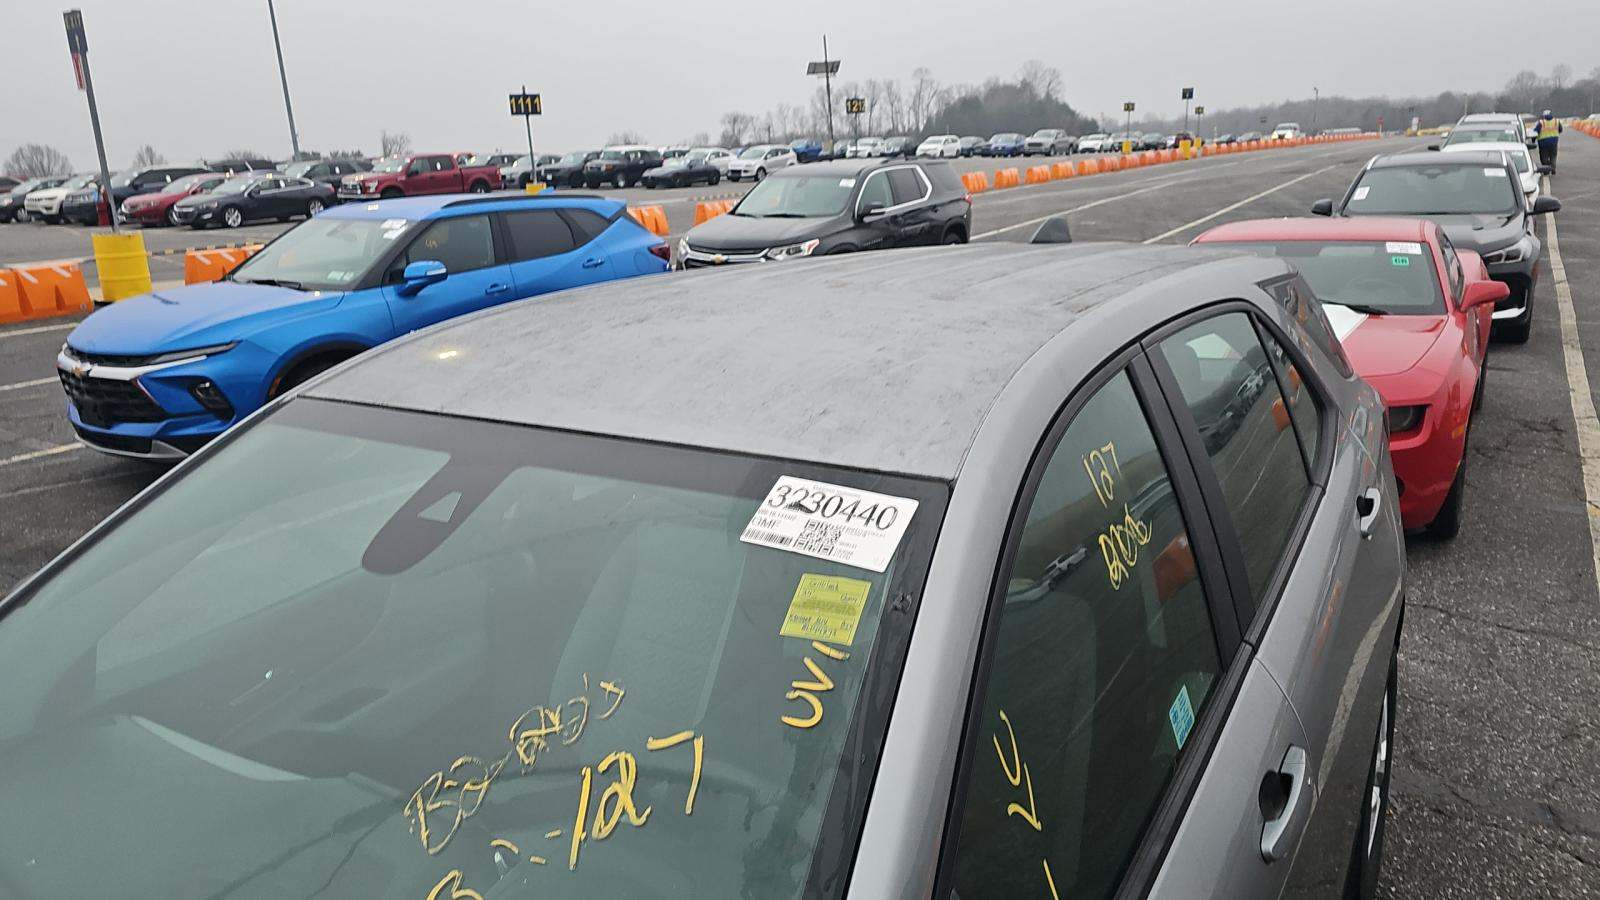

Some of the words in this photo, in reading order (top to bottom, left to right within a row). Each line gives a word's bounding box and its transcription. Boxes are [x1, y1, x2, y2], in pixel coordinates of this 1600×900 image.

[510, 95, 541, 113] 1111
[1082, 441, 1122, 509] 127
[768, 484, 899, 530] 3230440
